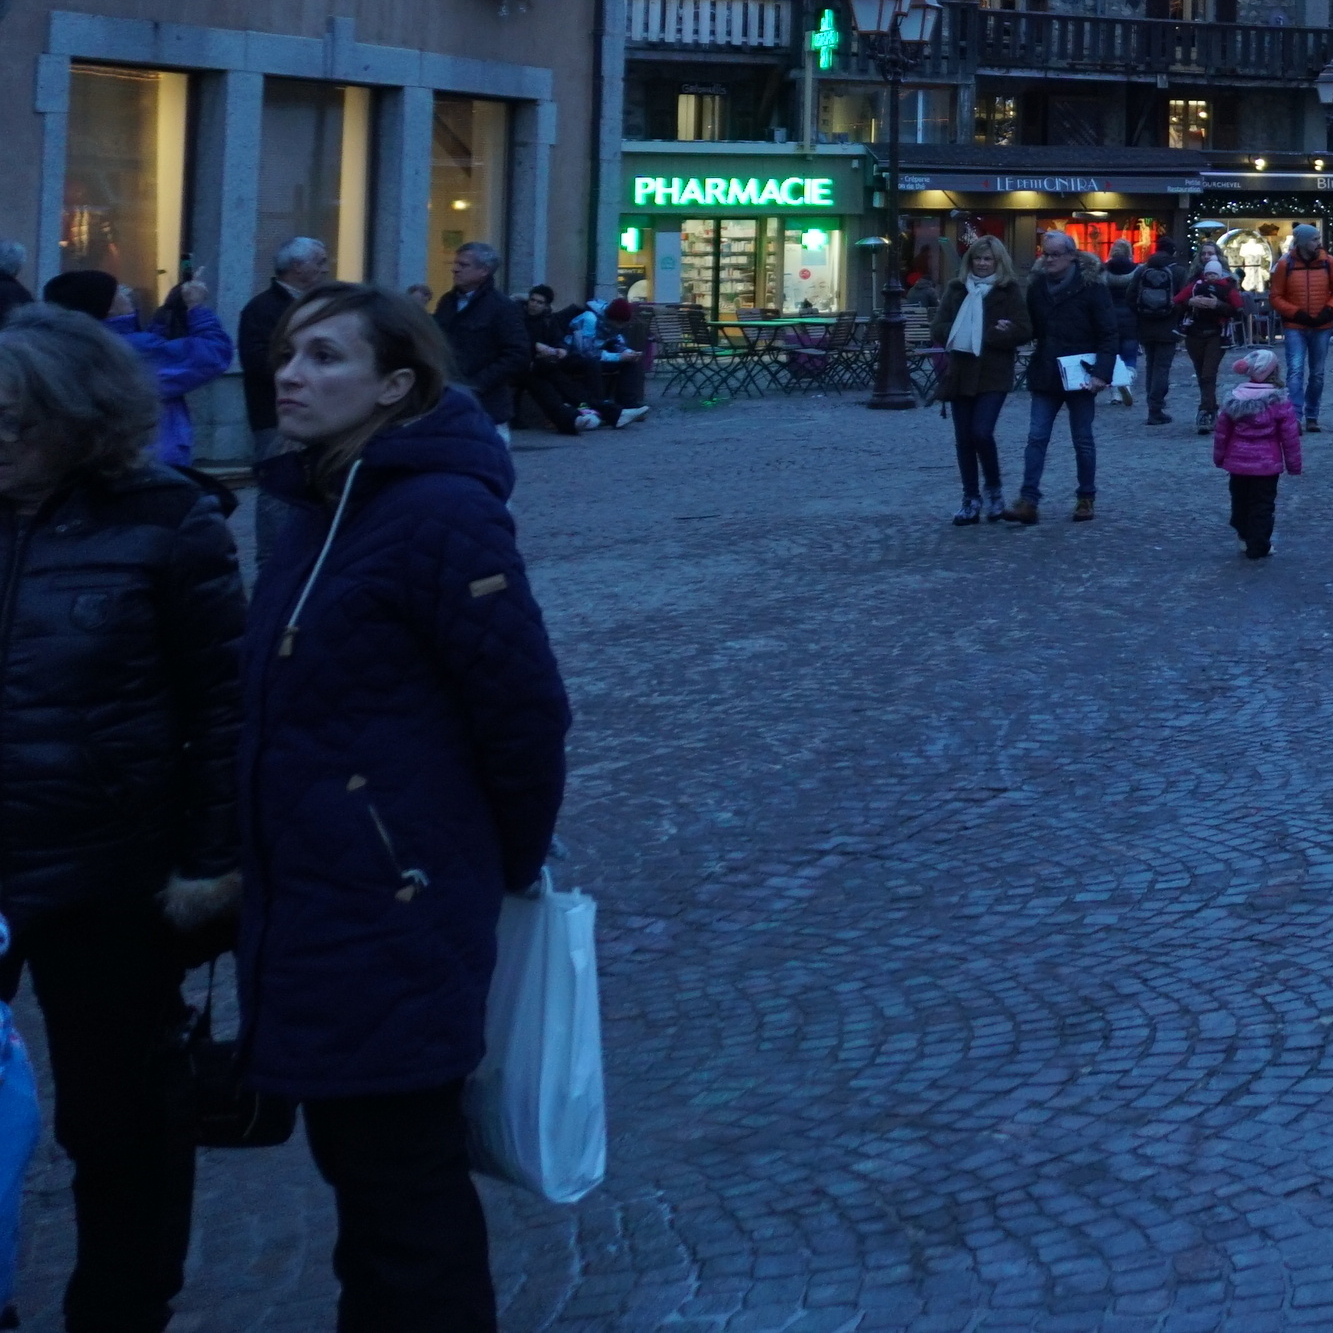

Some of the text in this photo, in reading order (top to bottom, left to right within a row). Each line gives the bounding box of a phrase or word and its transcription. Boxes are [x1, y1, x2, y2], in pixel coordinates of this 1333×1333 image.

[633, 176, 835, 207] PHARMACIE
[996, 177, 1014, 191] LE
[1043, 176, 1099, 192] CINTRA
[1202, 181, 1242, 189] OURCHEVEL
